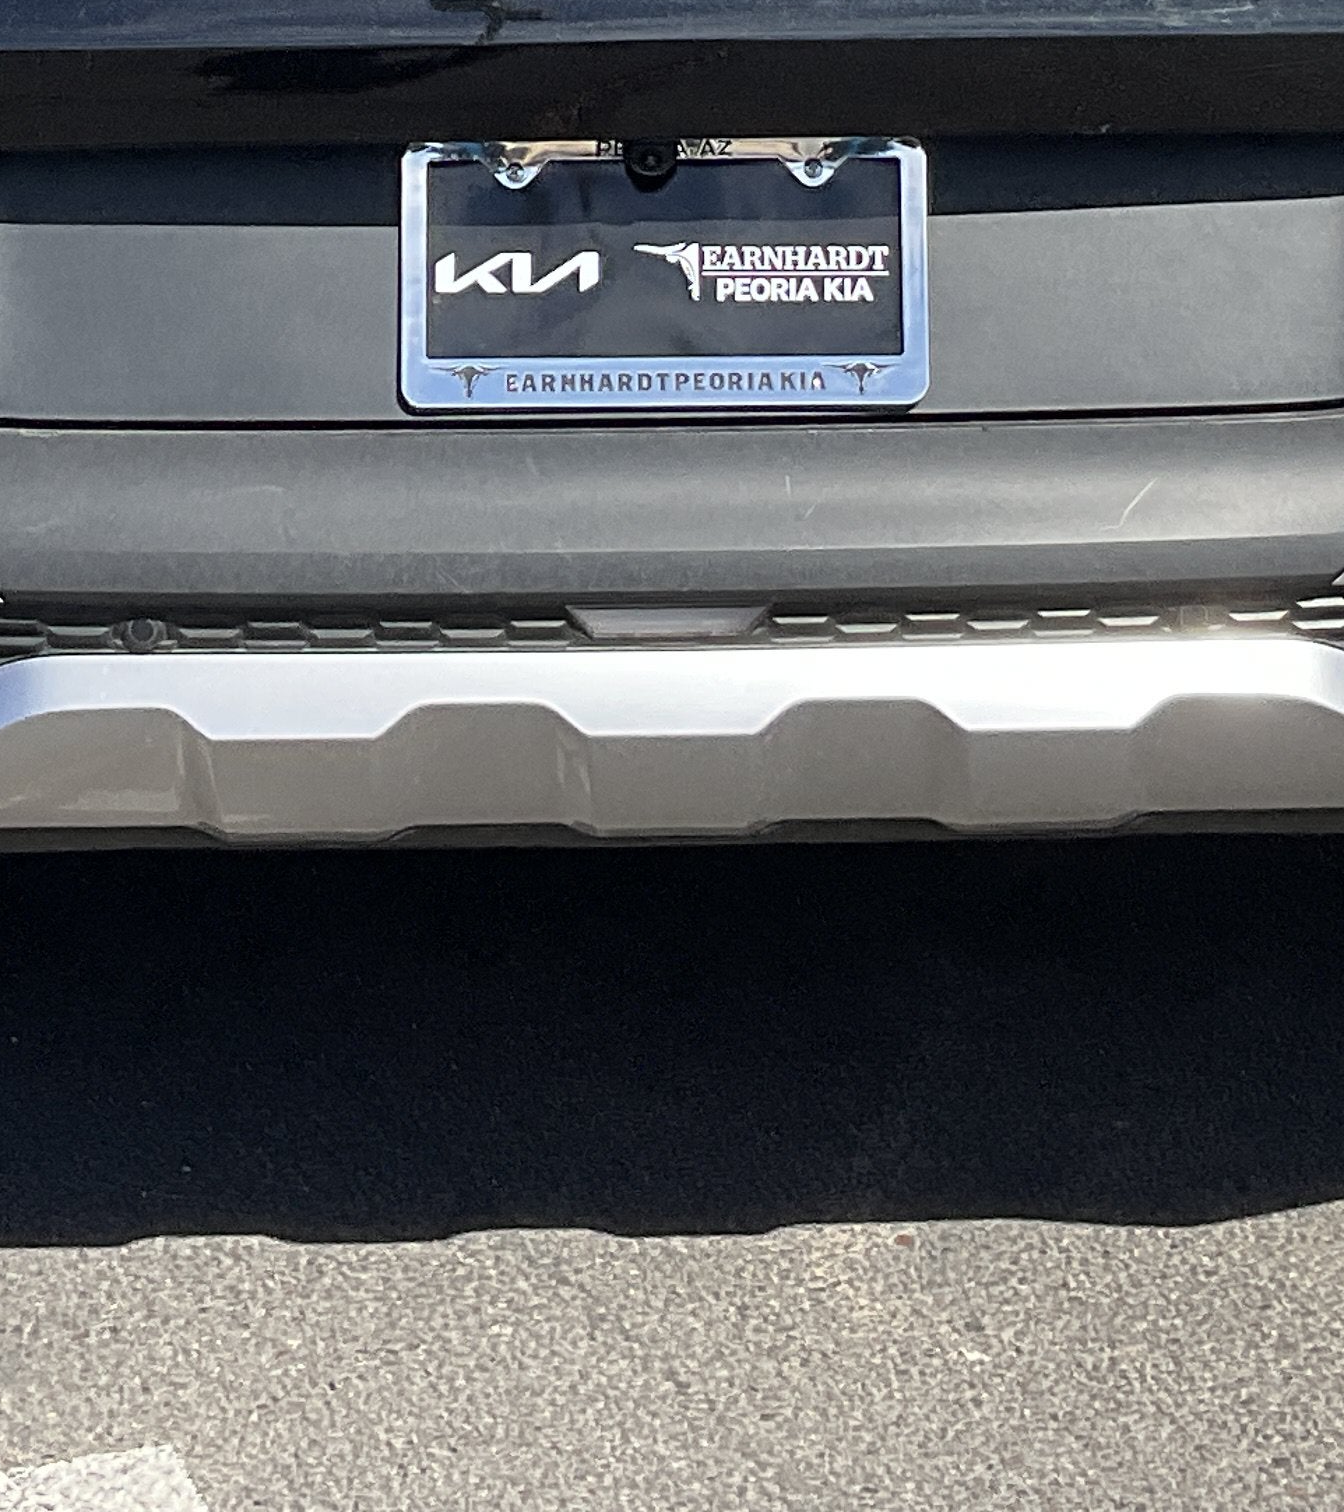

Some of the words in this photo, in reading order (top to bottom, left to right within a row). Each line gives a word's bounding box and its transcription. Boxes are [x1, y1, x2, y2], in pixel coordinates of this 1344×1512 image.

[701, 245, 890, 271] EARNHARDT
[435, 250, 600, 294] KIA
[716, 277, 819, 302] PEORIA
[823, 277, 874, 302] KIA
